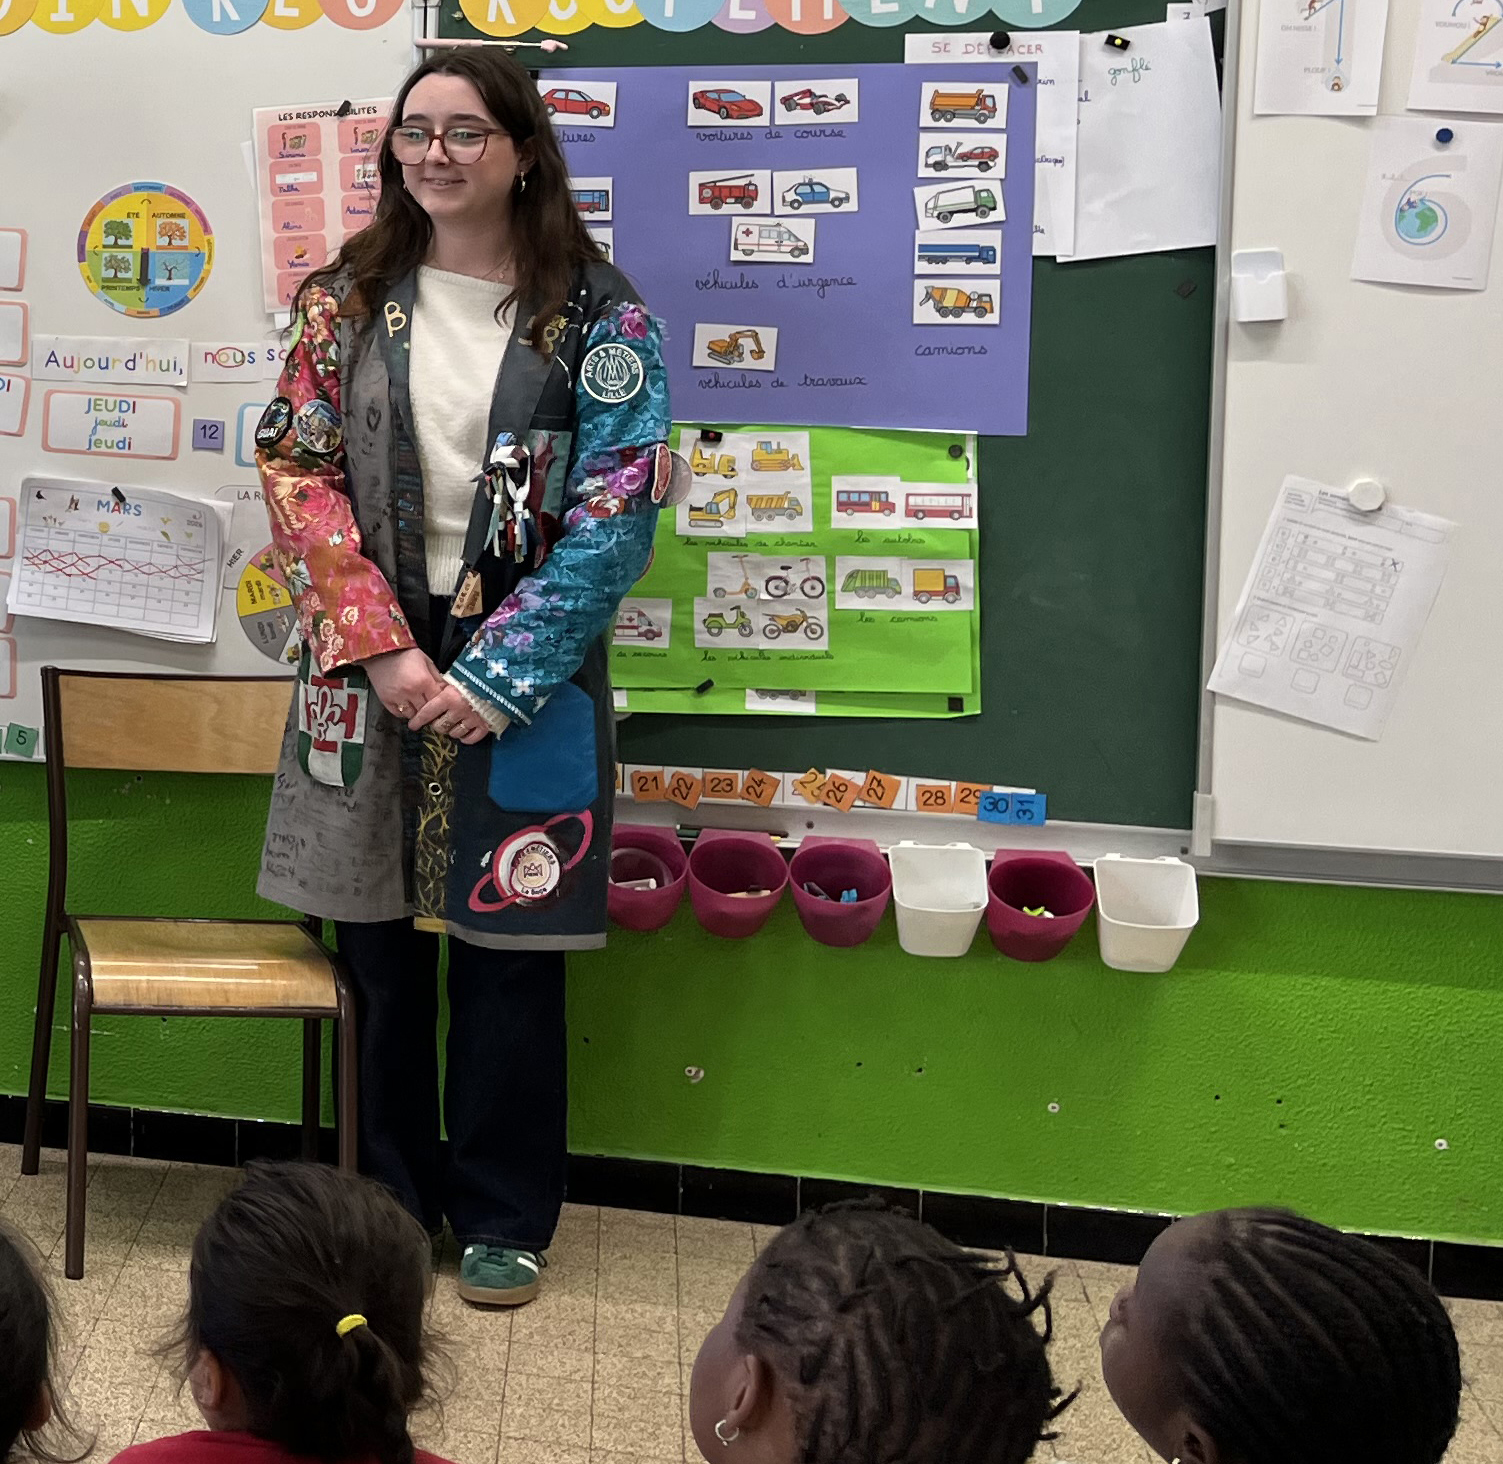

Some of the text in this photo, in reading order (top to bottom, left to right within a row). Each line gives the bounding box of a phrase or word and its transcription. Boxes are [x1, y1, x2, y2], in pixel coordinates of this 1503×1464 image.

[931, 41, 1044, 55] SE DÉACER
[278, 106, 378, 121] LES RESPONSILITES
[560, 129, 596, 143] tures
[696, 127, 847, 141] voitures de course
[151, 212, 186, 220] AUTOMNE
[695, 272, 858, 297] véhicules d'urgence
[914, 343, 988, 357] camions
[45, 350, 184, 376] Aujourd'hui,
[204, 348, 256, 366] nous
[697, 371, 869, 389] véhicules de travaux
[84, 398, 137, 415] JEUDI
[91, 415, 129, 435] jeudi
[200, 424, 219, 440] 12
[86, 436, 133, 452] jeudi
[237, 490, 251, 501] LA
[97, 499, 143, 517] MARS
[227, 547, 245, 569] HIER
[15, 730, 28, 745] 5
[637, 775, 659, 792] 21
[672, 776, 694, 800] 22
[710, 776, 734, 793] 23
[746, 776, 767, 799] 24
[826, 780, 849, 804] 26
[866, 775, 887, 801] 27
[921, 789, 946, 807] 28
[982, 795, 1009, 814] 30
[1015, 800, 1035, 821] 31
